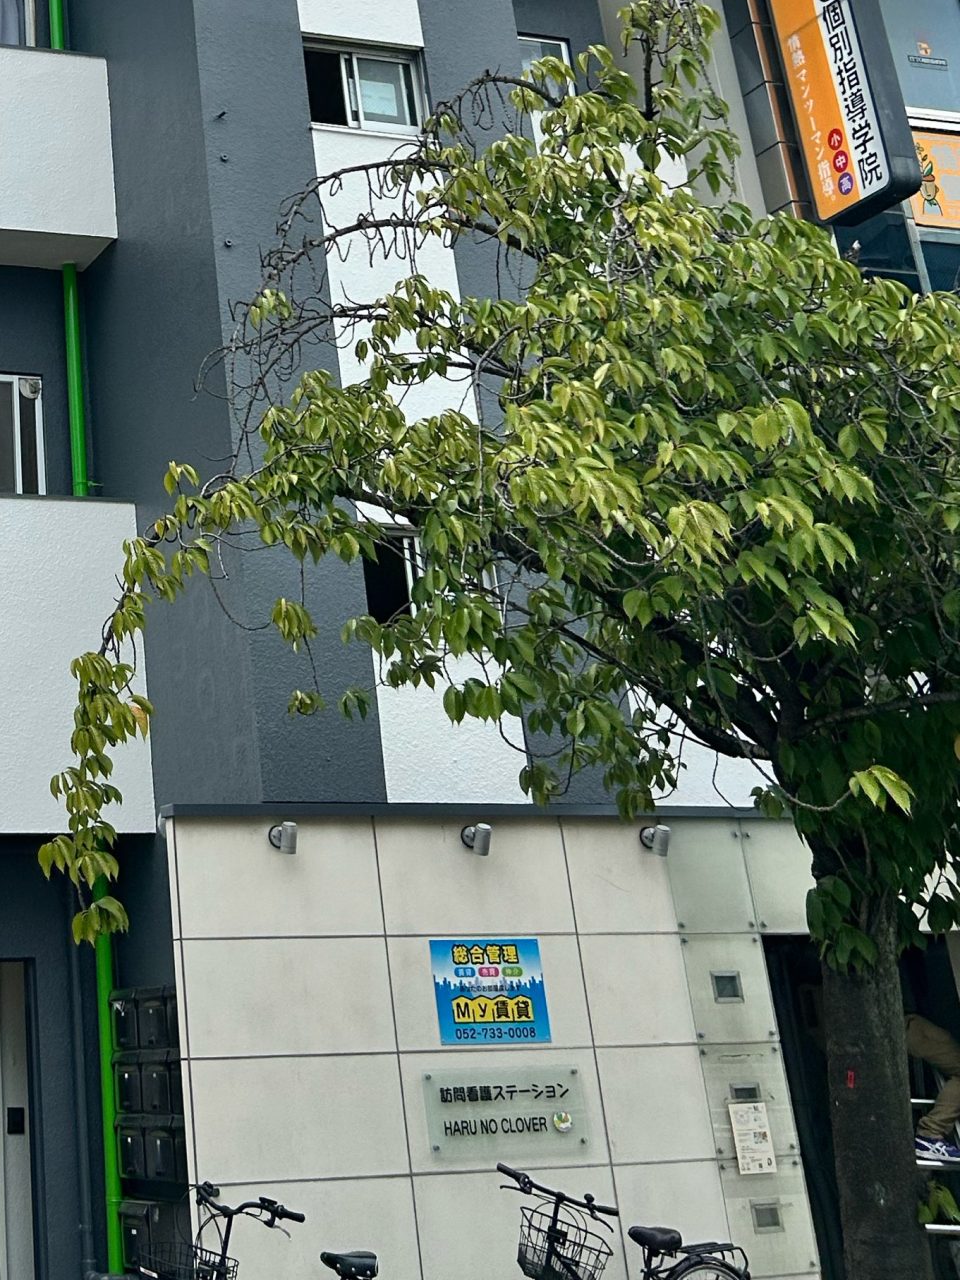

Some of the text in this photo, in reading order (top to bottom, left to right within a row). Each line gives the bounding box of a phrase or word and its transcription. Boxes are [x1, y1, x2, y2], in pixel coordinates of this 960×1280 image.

[452, 944, 519, 964] 総合管理
[455, 1027, 536, 1039] 052-733-0008
[440, 1083, 569, 1103] 訪問看護ステーション
[444, 1117, 548, 1136] HARU NO CLOVER
